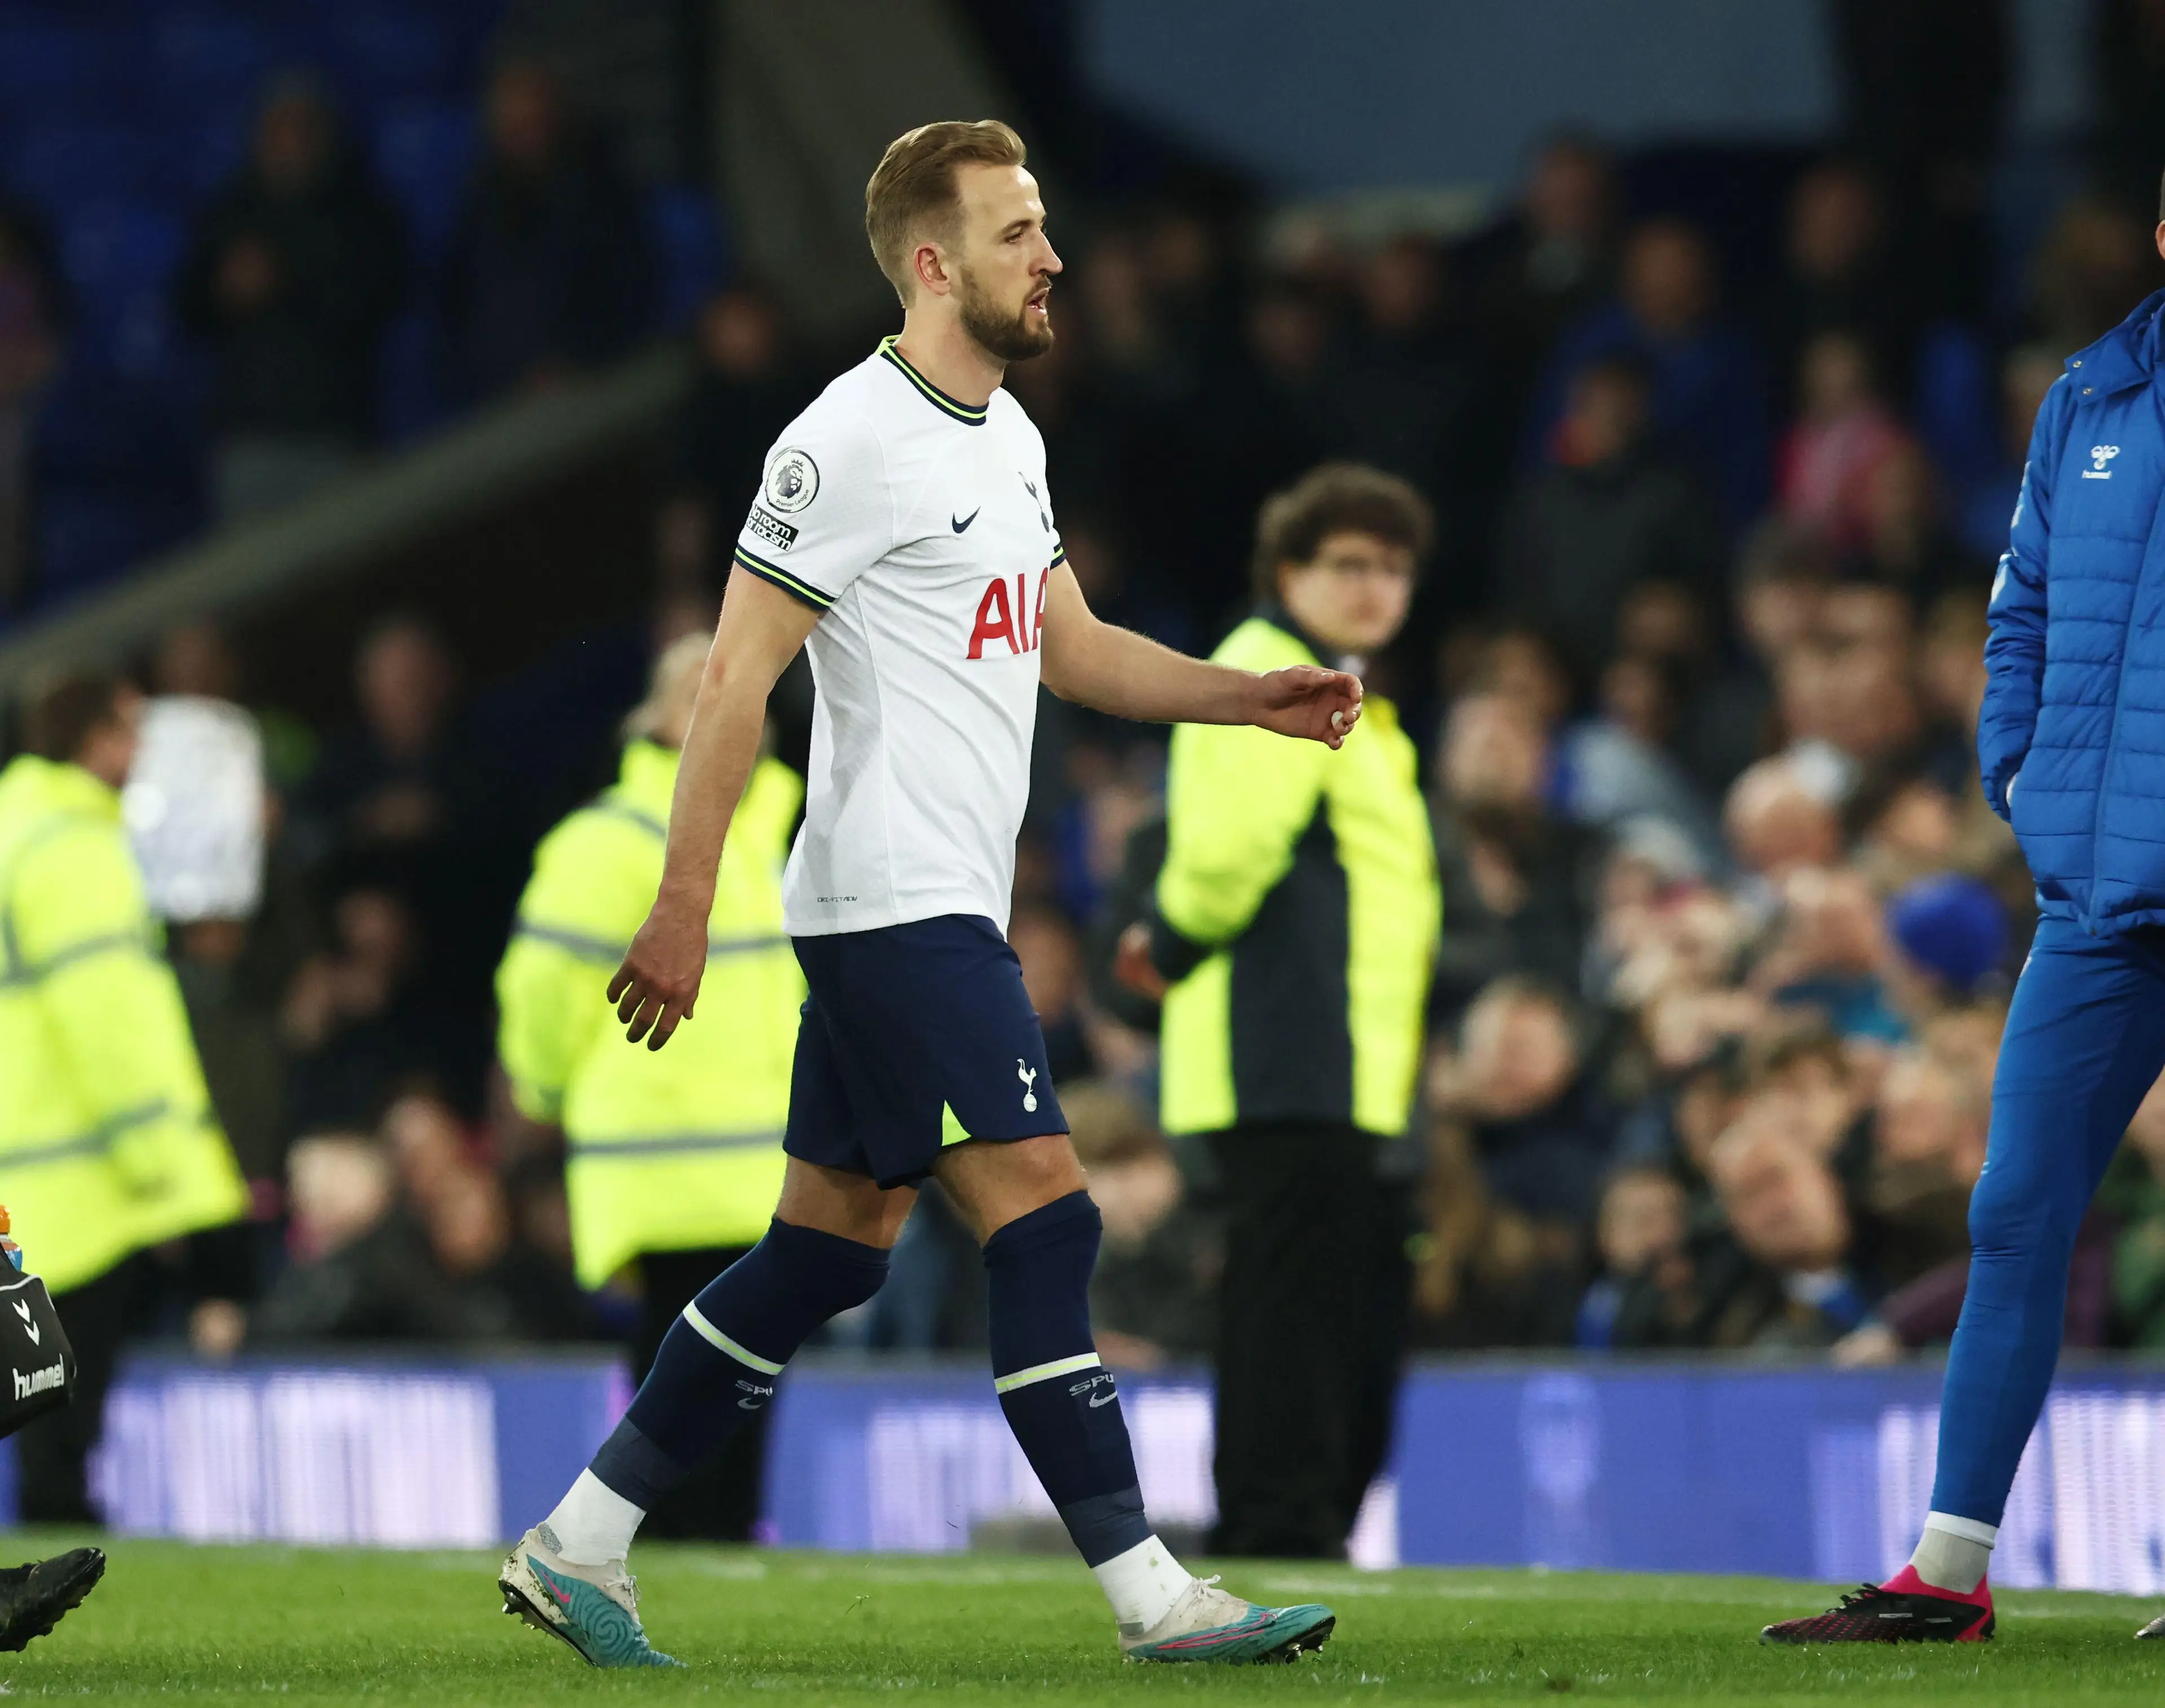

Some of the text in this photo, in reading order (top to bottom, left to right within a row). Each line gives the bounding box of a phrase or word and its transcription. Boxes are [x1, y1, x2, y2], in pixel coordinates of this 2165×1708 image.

[776, 489, 809, 507] Premier League
[753, 523, 792, 551] racism
[759, 513, 791, 538] room
[12, 1352, 64, 1401] hummel
